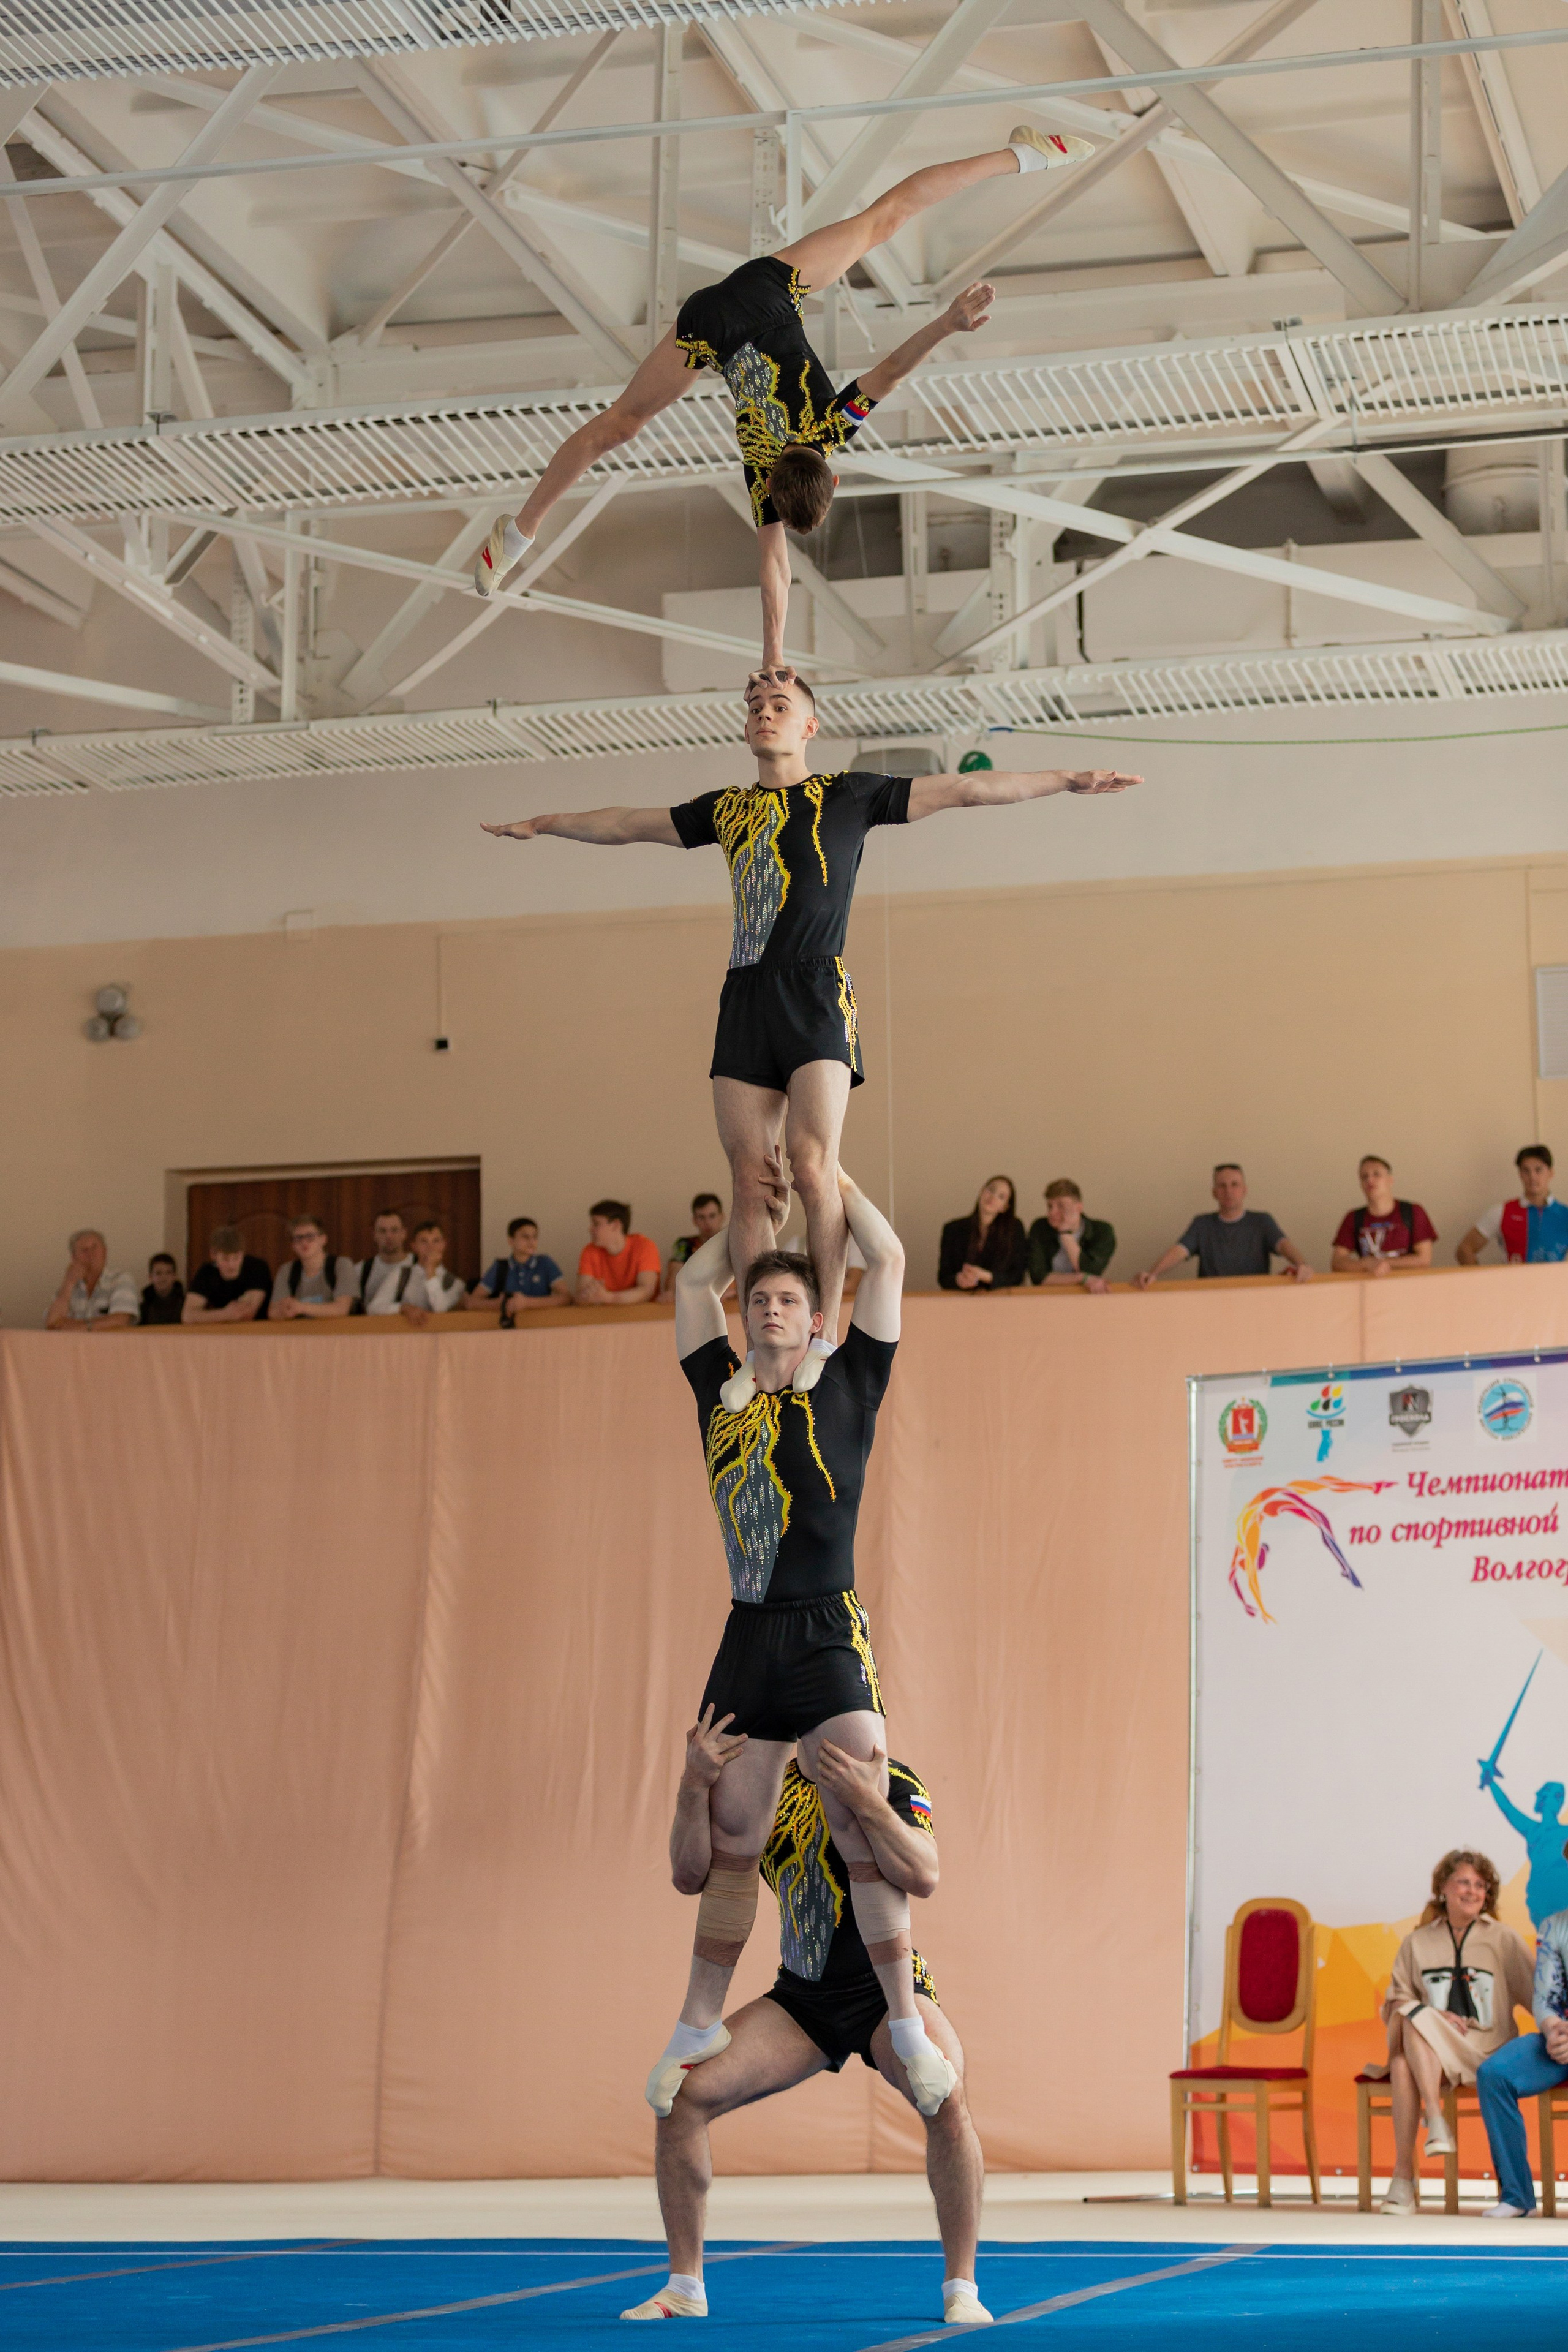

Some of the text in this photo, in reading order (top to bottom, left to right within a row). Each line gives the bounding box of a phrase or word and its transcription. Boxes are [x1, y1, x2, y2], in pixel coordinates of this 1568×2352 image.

[1407, 1468, 1568, 1498] Чемпионат
[1349, 1502, 1559, 1549] по спортивной
